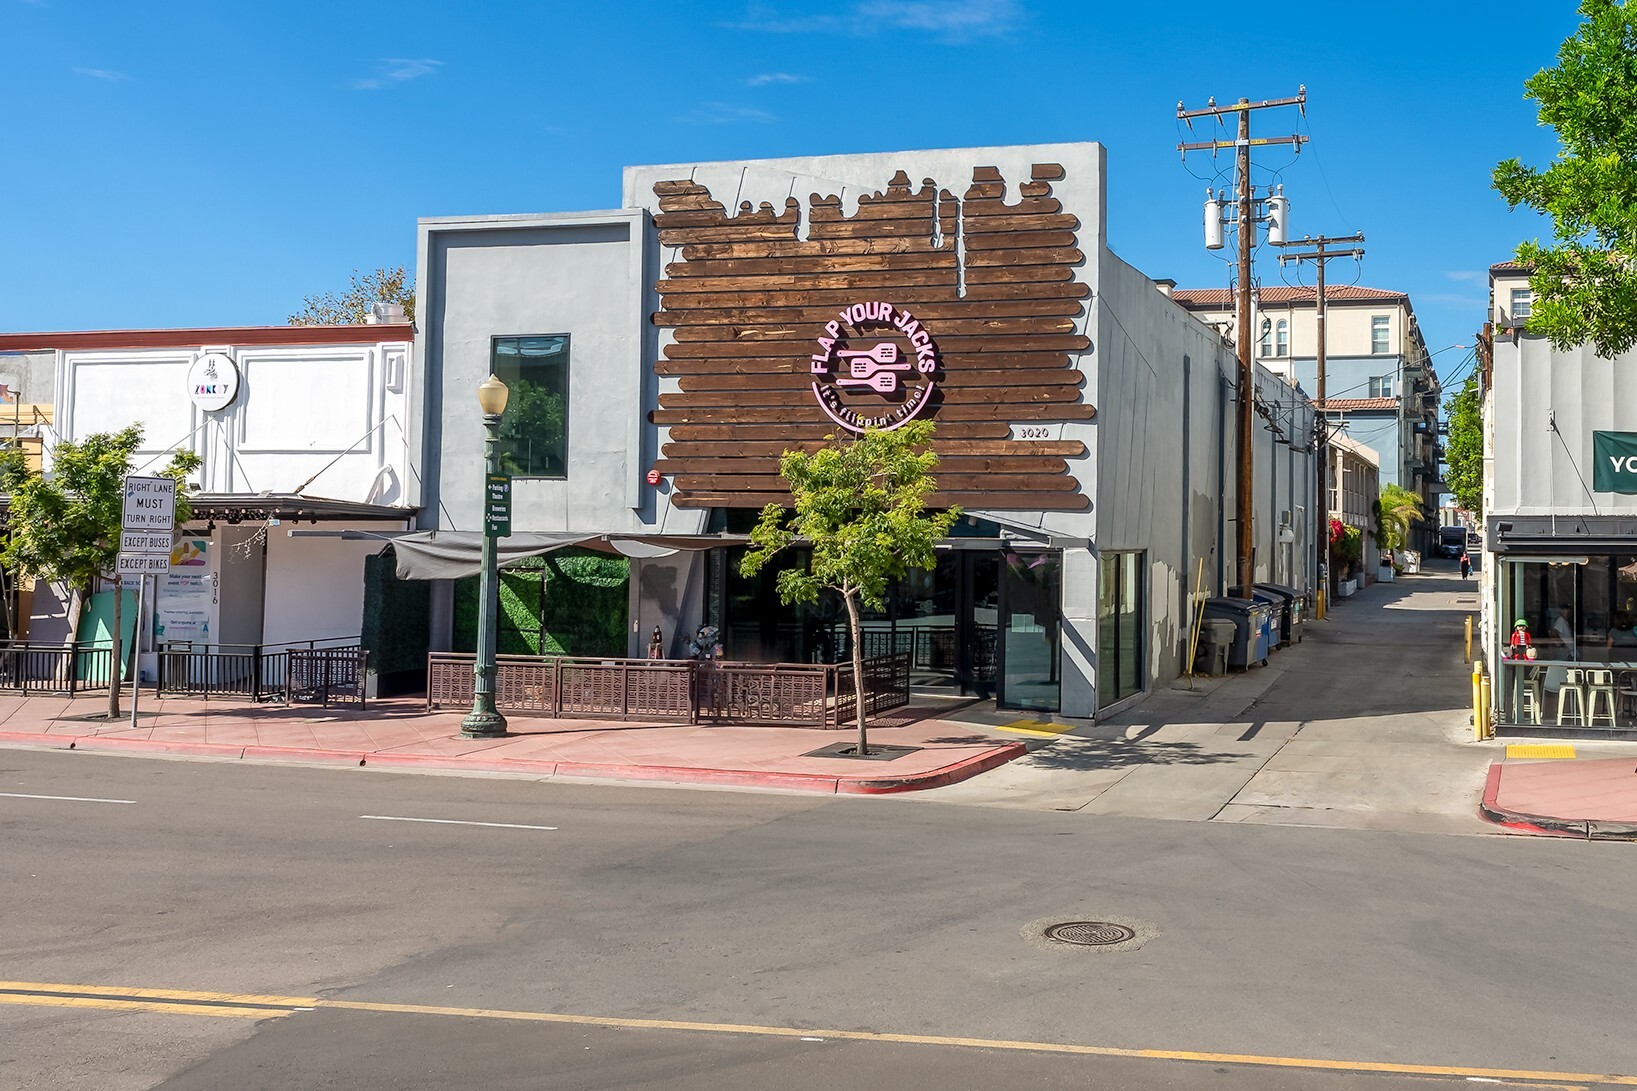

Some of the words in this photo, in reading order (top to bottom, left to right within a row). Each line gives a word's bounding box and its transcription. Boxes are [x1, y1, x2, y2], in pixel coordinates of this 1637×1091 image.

[811, 320, 840, 374] FLAP
[839, 301, 893, 326] YOUR
[893, 310, 935, 373] JACKS
[195, 384, 228, 394] ZONKY
[820, 384, 837, 409] It's
[896, 385, 925, 418] time!
[1020, 428, 1049, 438] 3020
[128, 482, 151, 492] RIGHT
[154, 484, 172, 493] LANE
[137, 498, 163, 509] MUST
[126, 514, 146, 523] TURN
[150, 514, 171, 524] RIGHT
[124, 537, 148, 547] EXCEPT
[150, 538, 169, 548] BUSES
[120, 559, 147, 568] EXCEPT
[149, 559, 167, 569] BIKES
